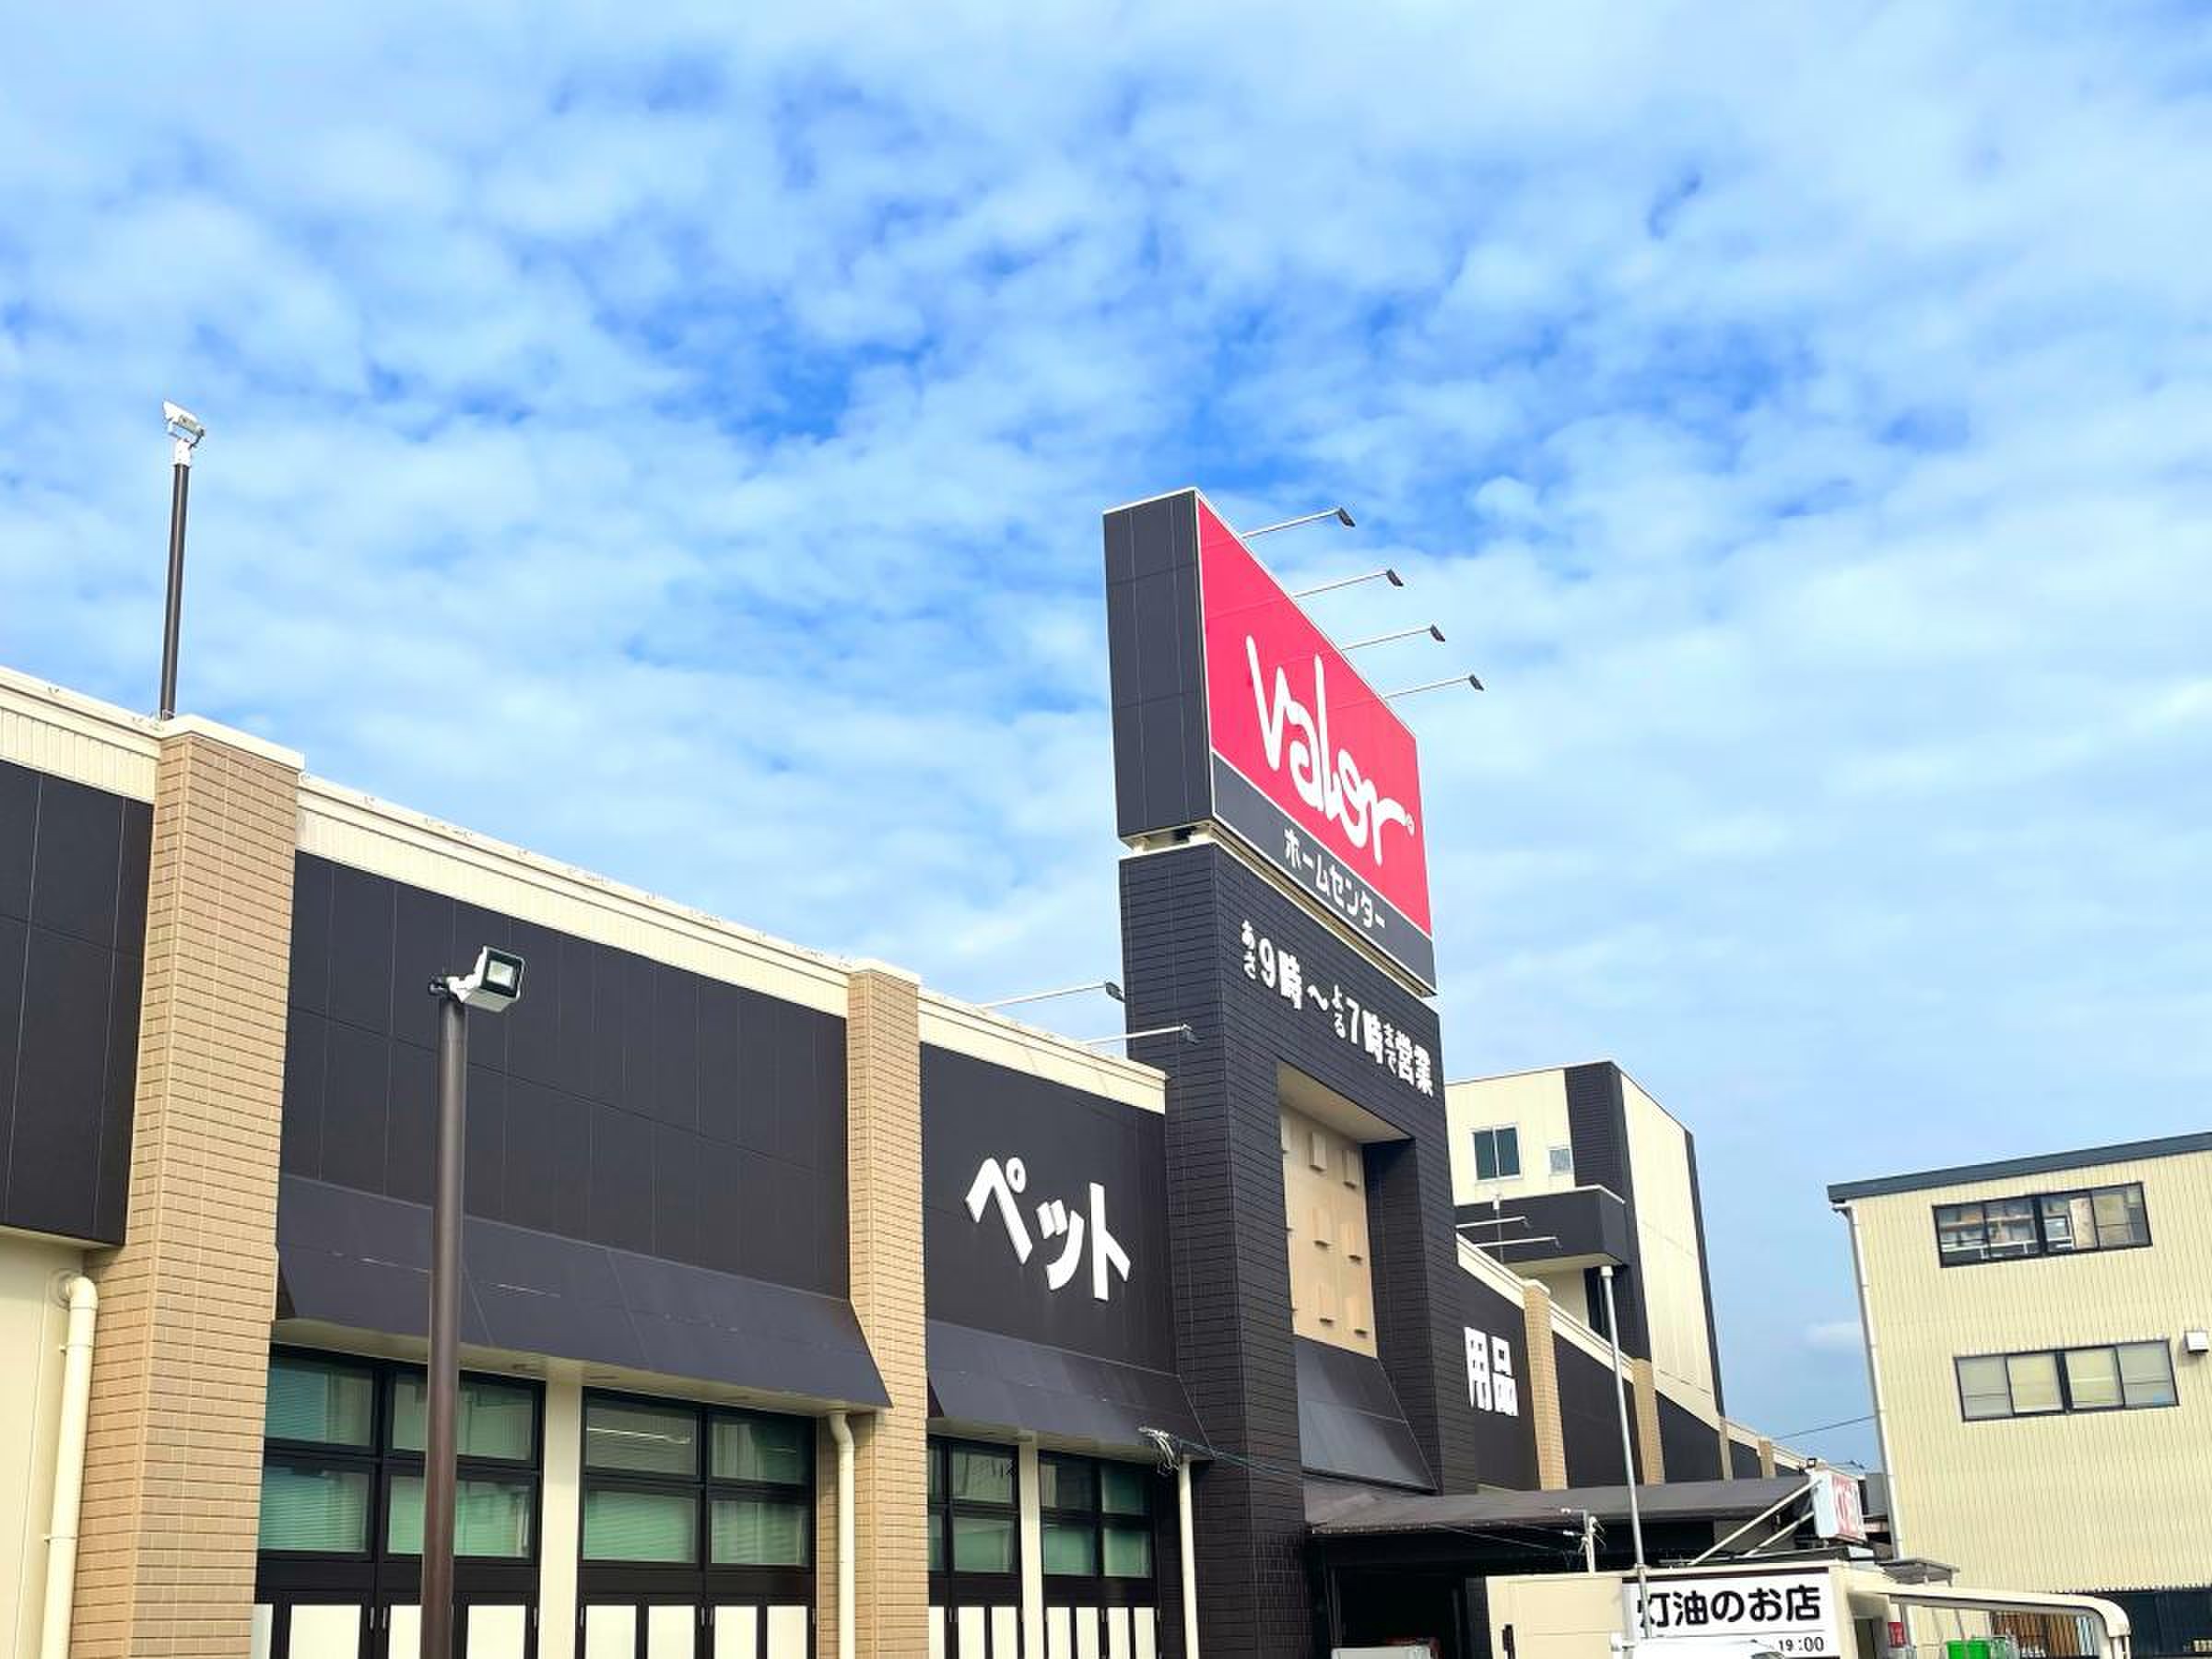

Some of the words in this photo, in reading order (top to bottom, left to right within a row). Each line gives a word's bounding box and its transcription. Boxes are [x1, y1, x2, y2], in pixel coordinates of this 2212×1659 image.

[1284, 829, 1385, 929] ホームセンター
[965, 1157, 1131, 1301] ペット
[1464, 1326, 1519, 1417] 用品
[1637, 1584, 1821, 1628] 灯油のお店
